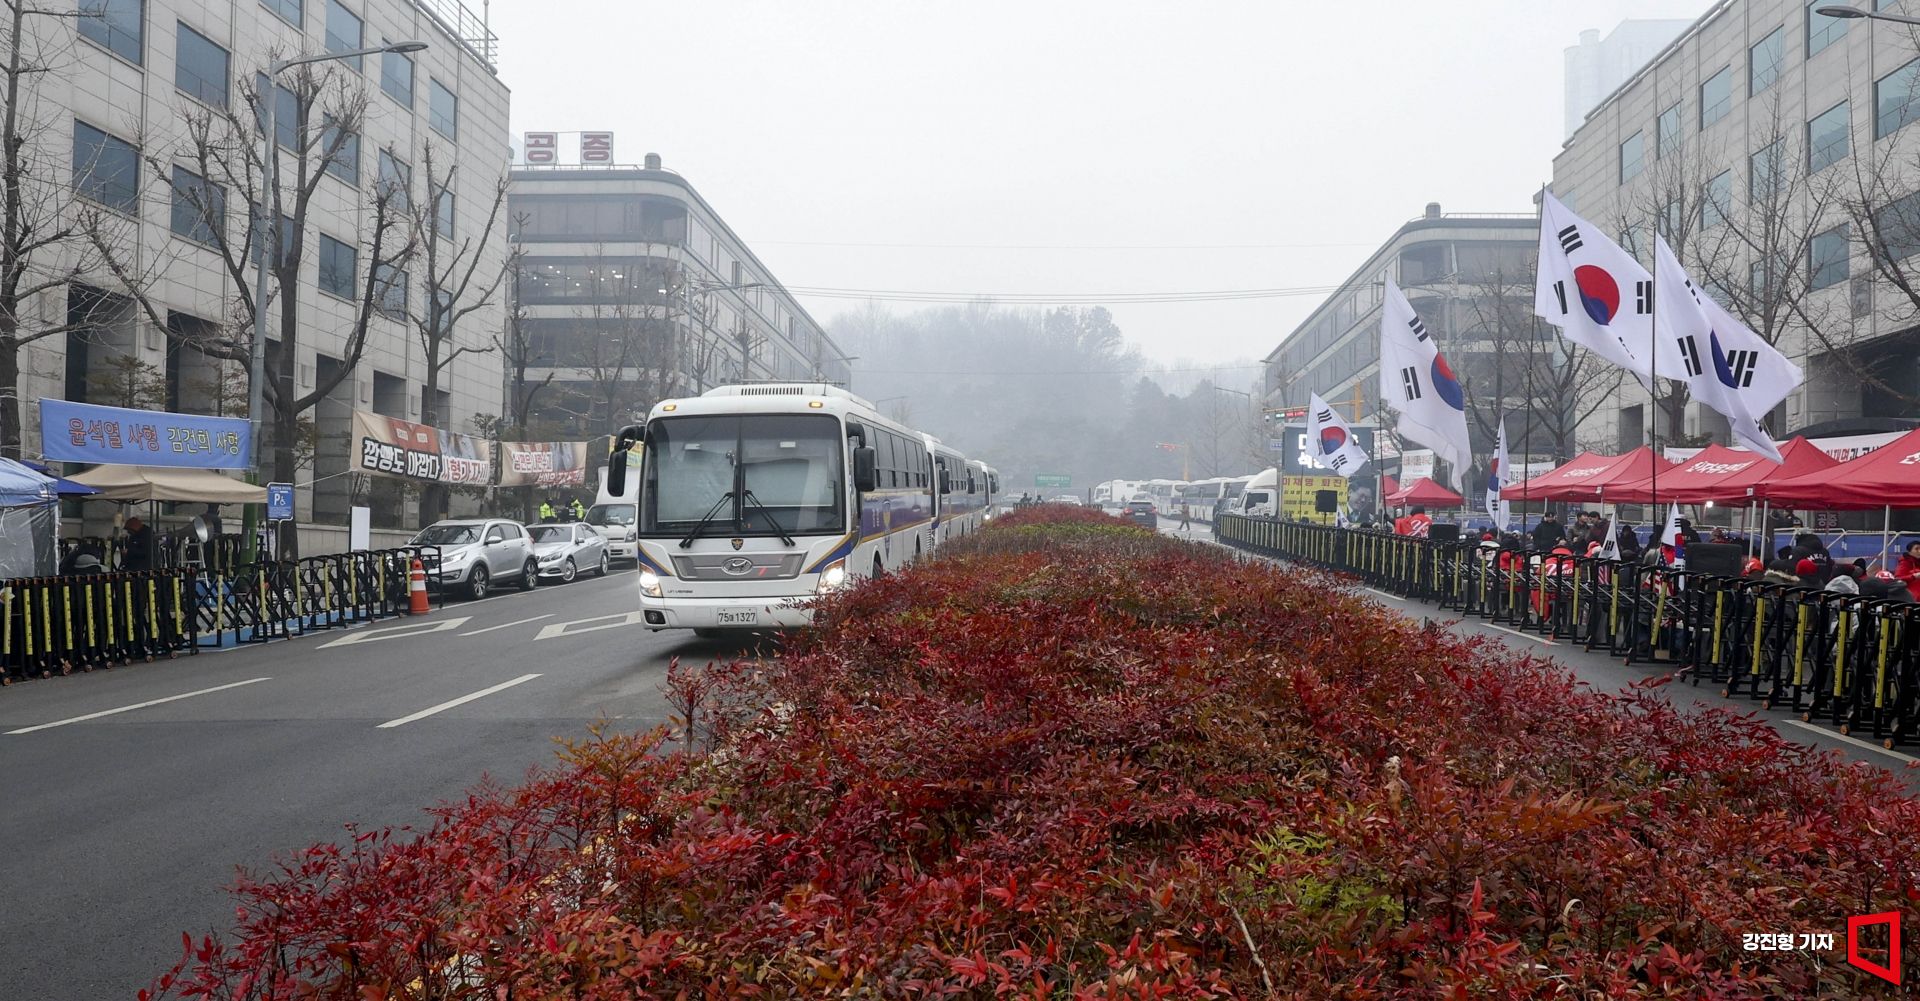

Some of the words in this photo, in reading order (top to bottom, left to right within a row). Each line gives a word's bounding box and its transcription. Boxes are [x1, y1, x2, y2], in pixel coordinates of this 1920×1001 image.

[527, 134, 611, 162] 공증
[68, 417, 123, 448] 윤석열
[128, 423, 160, 451] 사형
[167, 427, 212, 454] 김건희
[216, 431, 241, 456] 사형
[363, 440, 406, 474] 깜빵도
[407, 451, 441, 480] 아깝다
[273, 493, 281, 506] P
[735, 612, 756, 622] 1327
